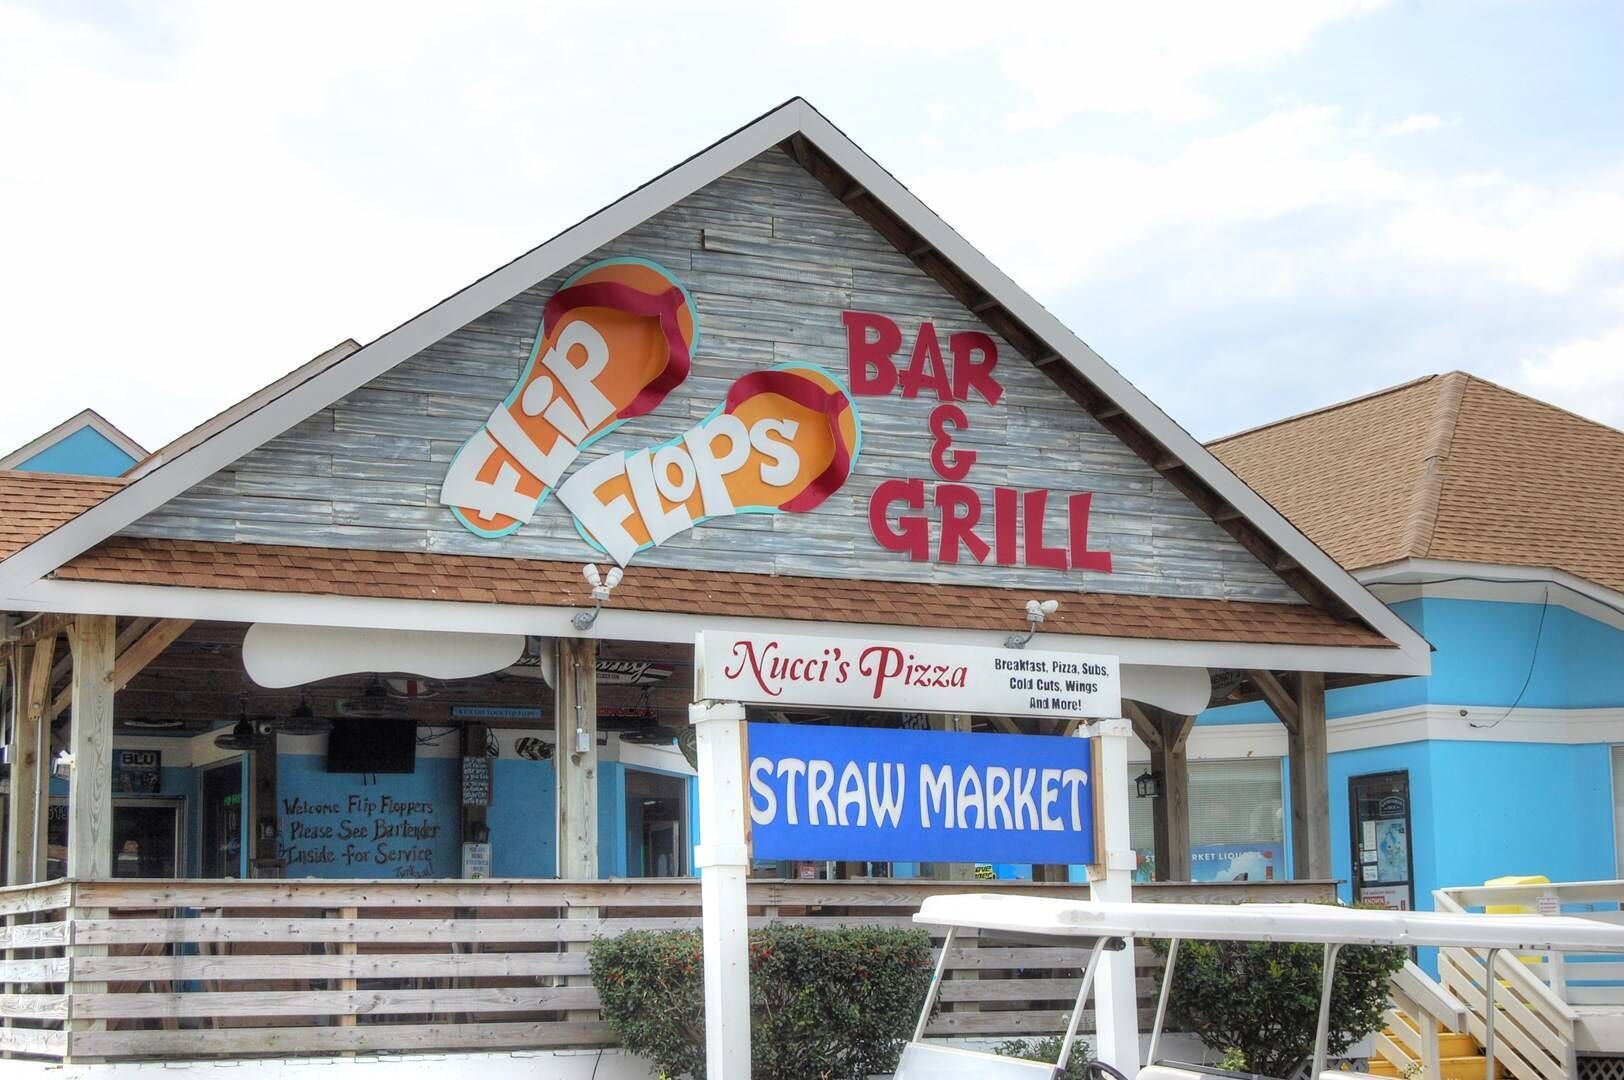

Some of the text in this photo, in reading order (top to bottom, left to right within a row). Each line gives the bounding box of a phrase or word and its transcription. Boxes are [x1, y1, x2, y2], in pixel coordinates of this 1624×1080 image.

[841, 309, 1006, 407] BAR
[928, 402, 978, 482] &
[556, 414, 801, 568] FLOPS
[867, 477, 1113, 575] GRILL
[724, 640, 969, 700] Nucci's Pizza
[1082, 662, 1109, 677] Subs,
[1009, 677, 1034, 690] Cold
[1065, 680, 1098, 694] Wings
[1029, 696, 1082, 711] And More!
[282, 794, 434, 816] Welcome Flip Floppers
[749, 756, 1089, 832] STRAW MARKET
[290, 818, 441, 841] Please See Bartender
[287, 842, 434, 865] Inside for Service
[1191, 853, 1217, 862] RKET
